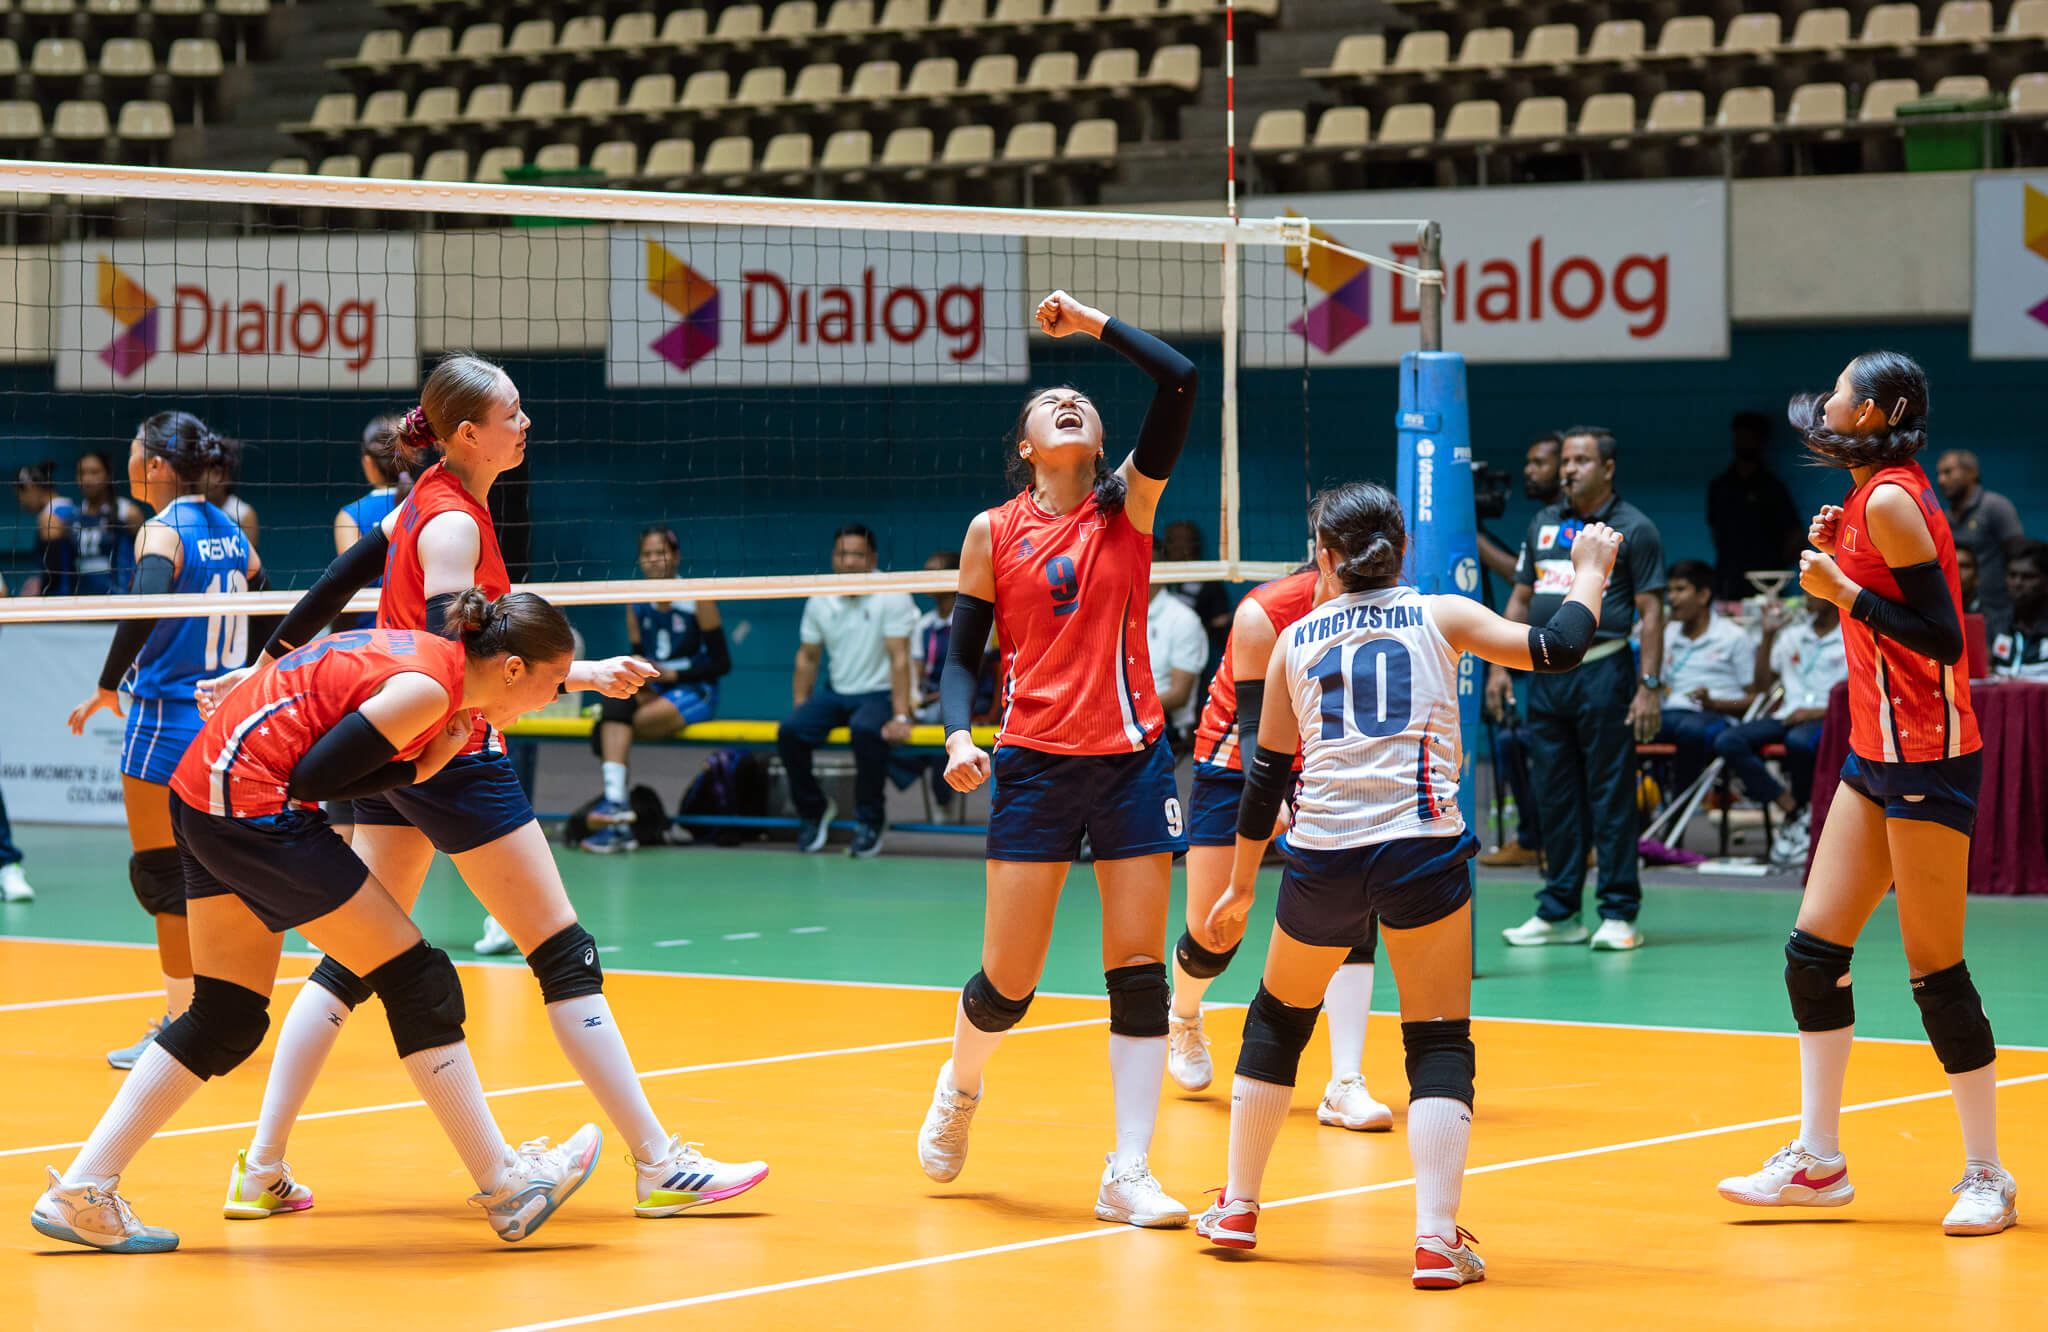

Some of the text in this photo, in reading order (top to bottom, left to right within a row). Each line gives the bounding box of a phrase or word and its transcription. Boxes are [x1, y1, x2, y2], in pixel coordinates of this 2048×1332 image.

[172, 283, 377, 371] Dialog
[742, 265, 985, 361] Dialog
[1390, 237, 1669, 338] Dialog
[204, 569, 249, 671] 10
[1045, 555, 1079, 602] 9
[1294, 605, 1424, 649] KYRGYZSTAN
[1307, 638, 1412, 741] 10
[1164, 797, 1183, 838] 9
